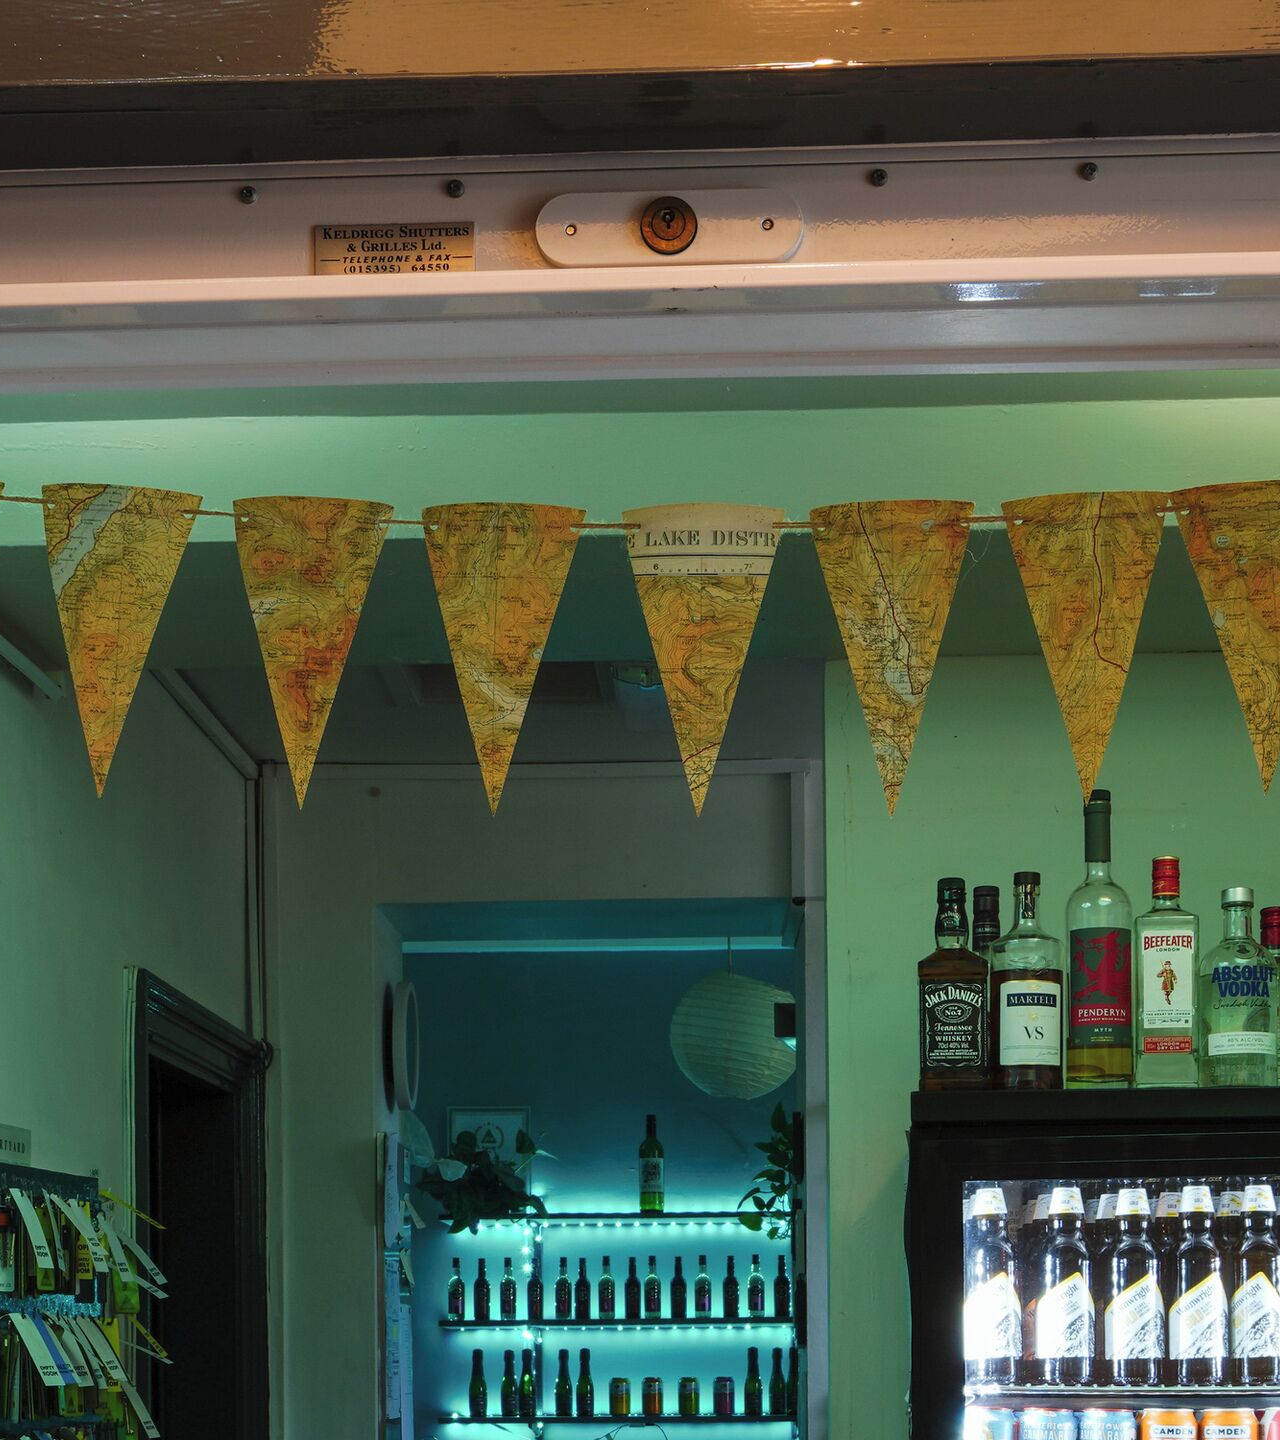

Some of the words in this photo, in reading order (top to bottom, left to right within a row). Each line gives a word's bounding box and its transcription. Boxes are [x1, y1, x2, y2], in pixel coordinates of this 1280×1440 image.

[322, 227, 394, 239] KELDRIGG
[399, 225, 470, 238] SHUTTERS
[346, 242, 357, 252] &
[361, 239, 418, 252] GRILLES
[422, 238, 447, 250] Ltd.
[342, 255, 410, 264] TELEPHONE
[429, 253, 451, 261] FAX
[344, 264, 401, 274] (015395)
[411, 263, 450, 272] 64550
[643, 530, 701, 548] LAKE
[711, 530, 777, 548] DISTR
[1143, 935, 1193, 950] BEEFEATER
[1218, 981, 1270, 998] VODKA
[924, 990, 948, 1008] JACK
[1009, 996, 1055, 1005] MARTELL
[1078, 1008, 1126, 1017] PENDERYN
[934, 1022, 973, 1031] Tennessee
[1024, 1026, 1044, 1040] VS
